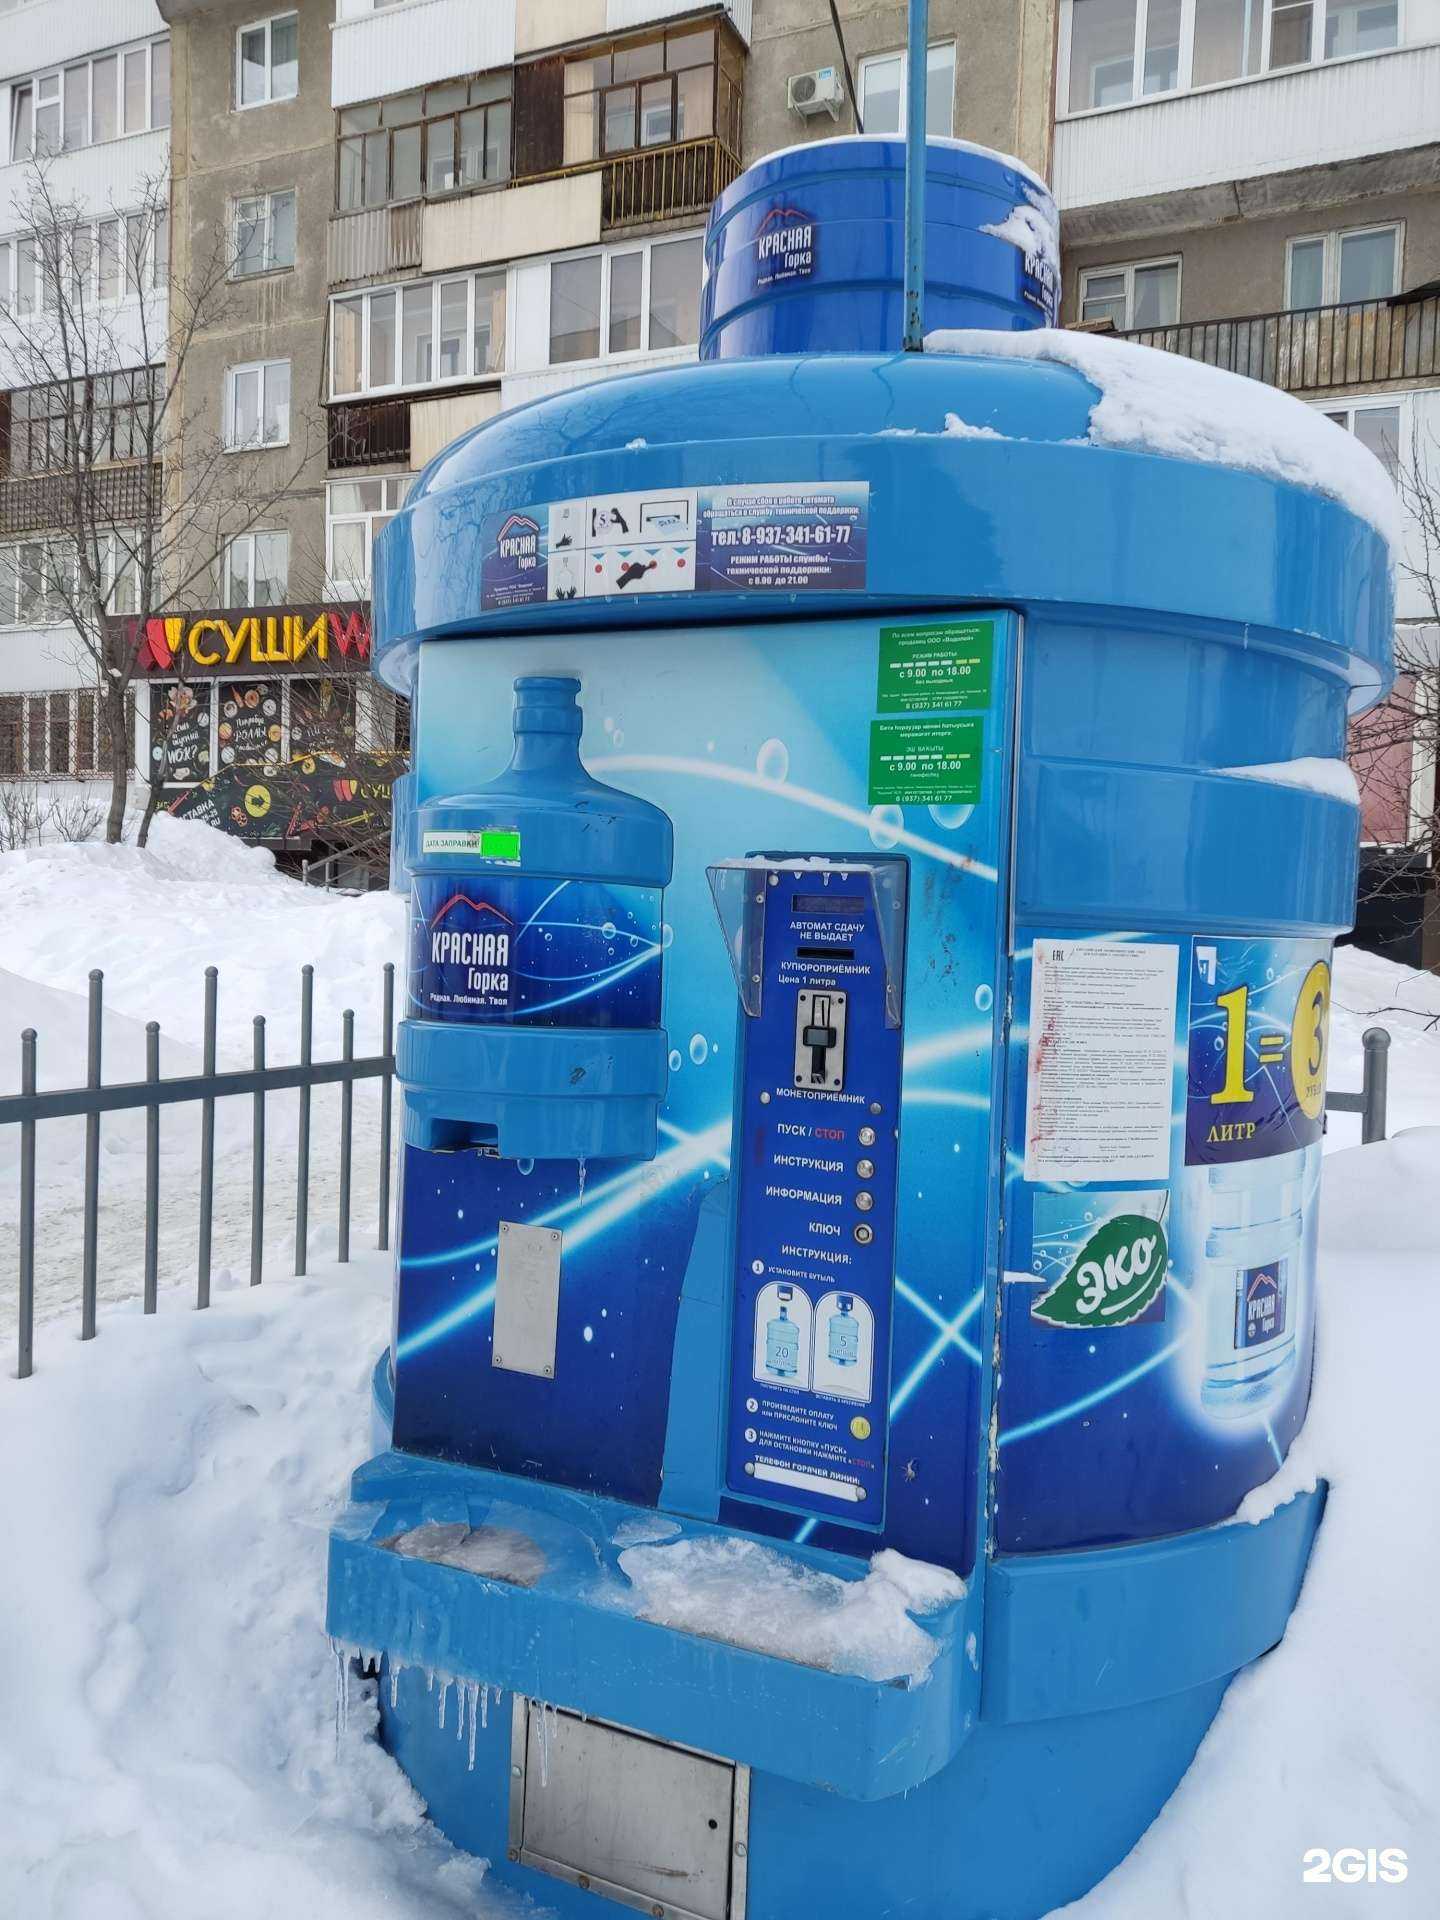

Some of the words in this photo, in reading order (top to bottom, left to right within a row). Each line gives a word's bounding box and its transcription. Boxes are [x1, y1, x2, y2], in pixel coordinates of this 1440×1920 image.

[758, 224, 812, 260] КРАСНАЯ
[784, 251, 812, 269] Горка
[741, 525, 851, 546] 8-937-341-61-77
[500, 534, 537, 558] КРАСНАЯ
[518, 556, 537, 570] Горка
[730, 555, 759, 564] РЕЖИМ
[760, 555, 792, 563] РАБОТЫ
[793, 554, 828, 564] службы
[727, 565, 779, 575] технической
[774, 577, 786, 586] до
[787, 576, 809, 585] 21.00
[907, 668, 926, 677] 9.00
[931, 669, 944, 677] по
[946, 666, 971, 676] 18.00
[897, 762, 917, 771] 9.00
[936, 761, 961, 770] 18.00
[789, 921, 832, 931] АВТОМАТ
[834, 923, 865, 933] СДАЧУ
[800, 932, 812, 940] НЕ
[431, 932, 509, 966] КРАСНАЯ
[467, 967, 509, 994] Горка
[778, 974, 800, 984] Цена
[802, 975, 807, 984] 1
[808, 977, 836, 987] литра
[488, 996, 508, 1006] Твоя
[1210, 985, 1254, 1105] 1
[777, 1123, 806, 1137] ПУСК
[814, 1127, 845, 1141] СТОП
[1206, 1122, 1256, 1143] ЛИТР
[773, 1154, 844, 1173] ИНСТРУКЦИЯ
[766, 1186, 842, 1206] ИНФОРМАЦИЯ
[809, 1222, 841, 1237] КЛЮЧ
[781, 1244, 852, 1265] ИНСТРУКЦИЯ:
[768, 1265, 808, 1279] УСТАНОВИТЕ
[808, 1272, 835, 1283] БУТЫЛЬ
[1076, 1234, 1157, 1315] ЭКО
[840, 1335, 847, 1348] 5
[775, 1346, 789, 1359] 20
[762, 1400, 807, 1415] ПРОИЗВЕДИТЕ
[808, 1409, 834, 1421] ОПЛАТУ
[774, 1412, 817, 1427] ПРИСЛОНИТЕ
[818, 1421, 838, 1431] КЛЮЧ
[759, 1430, 791, 1442] НАЖМИТЕ
[792, 1437, 819, 1448] КНОПКУ
[759, 1438, 773, 1447] ДЛЯ
[773, 1442, 812, 1455] ОСТАНОВКИ
[813, 1450, 847, 1463] НАЖМИТЕ
[754, 1454, 791, 1469] ТЕЛЕФОН
[792, 1461, 828, 1477] ГОРЯЧЕЙ
[829, 1471, 861, 1485] ЛИНИИ:
